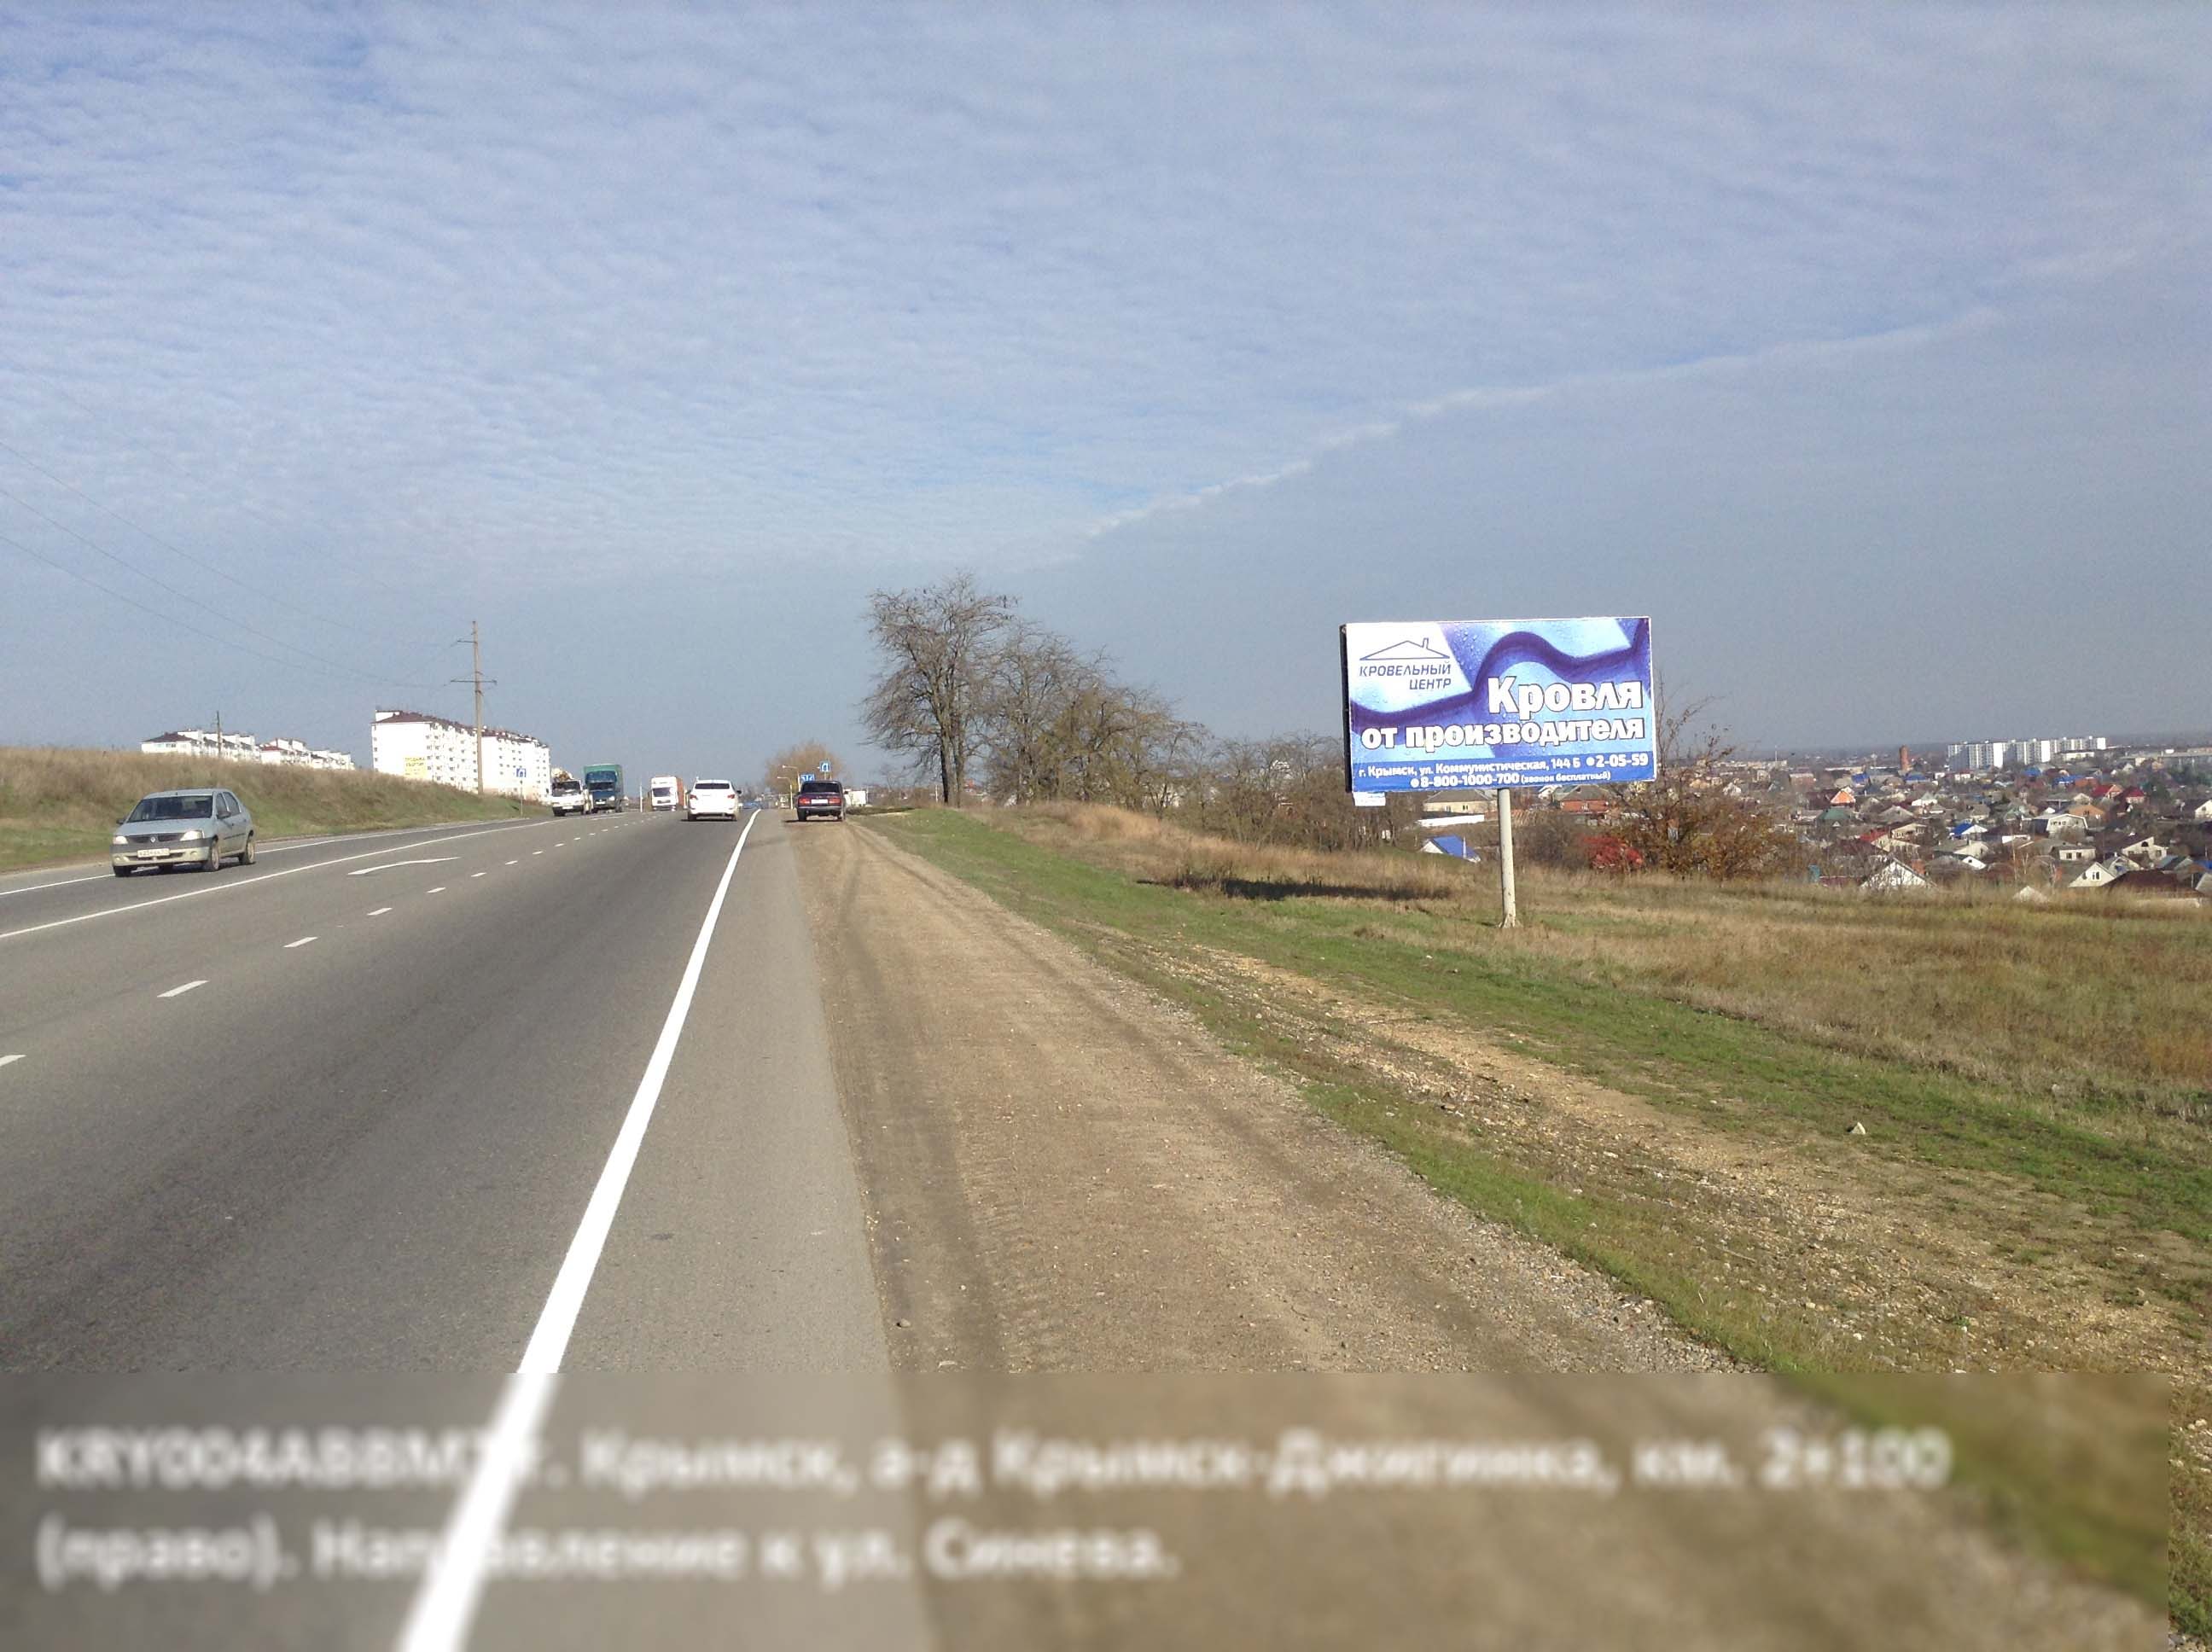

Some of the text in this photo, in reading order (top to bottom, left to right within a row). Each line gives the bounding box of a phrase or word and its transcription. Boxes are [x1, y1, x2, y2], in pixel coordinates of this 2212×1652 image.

[1359, 660, 1452, 677] КРОВЕЛЬНЫЙ
[1409, 678, 1452, 690] ЦЕНТР
[1487, 675, 1644, 721] Кровля
[1360, 717, 1645, 753] от производителя
[1358, 769, 1366, 777] г.
[1367, 765, 1417, 778] Крымск,
[1418, 768, 1434, 777] ул.
[1435, 761, 1550, 775] Коммунистическая,
[1551, 758, 1571, 770] 144
[1595, 753, 1649, 768] 2-05-59
[1420, 771, 1521, 788] 8-800-1000-700
